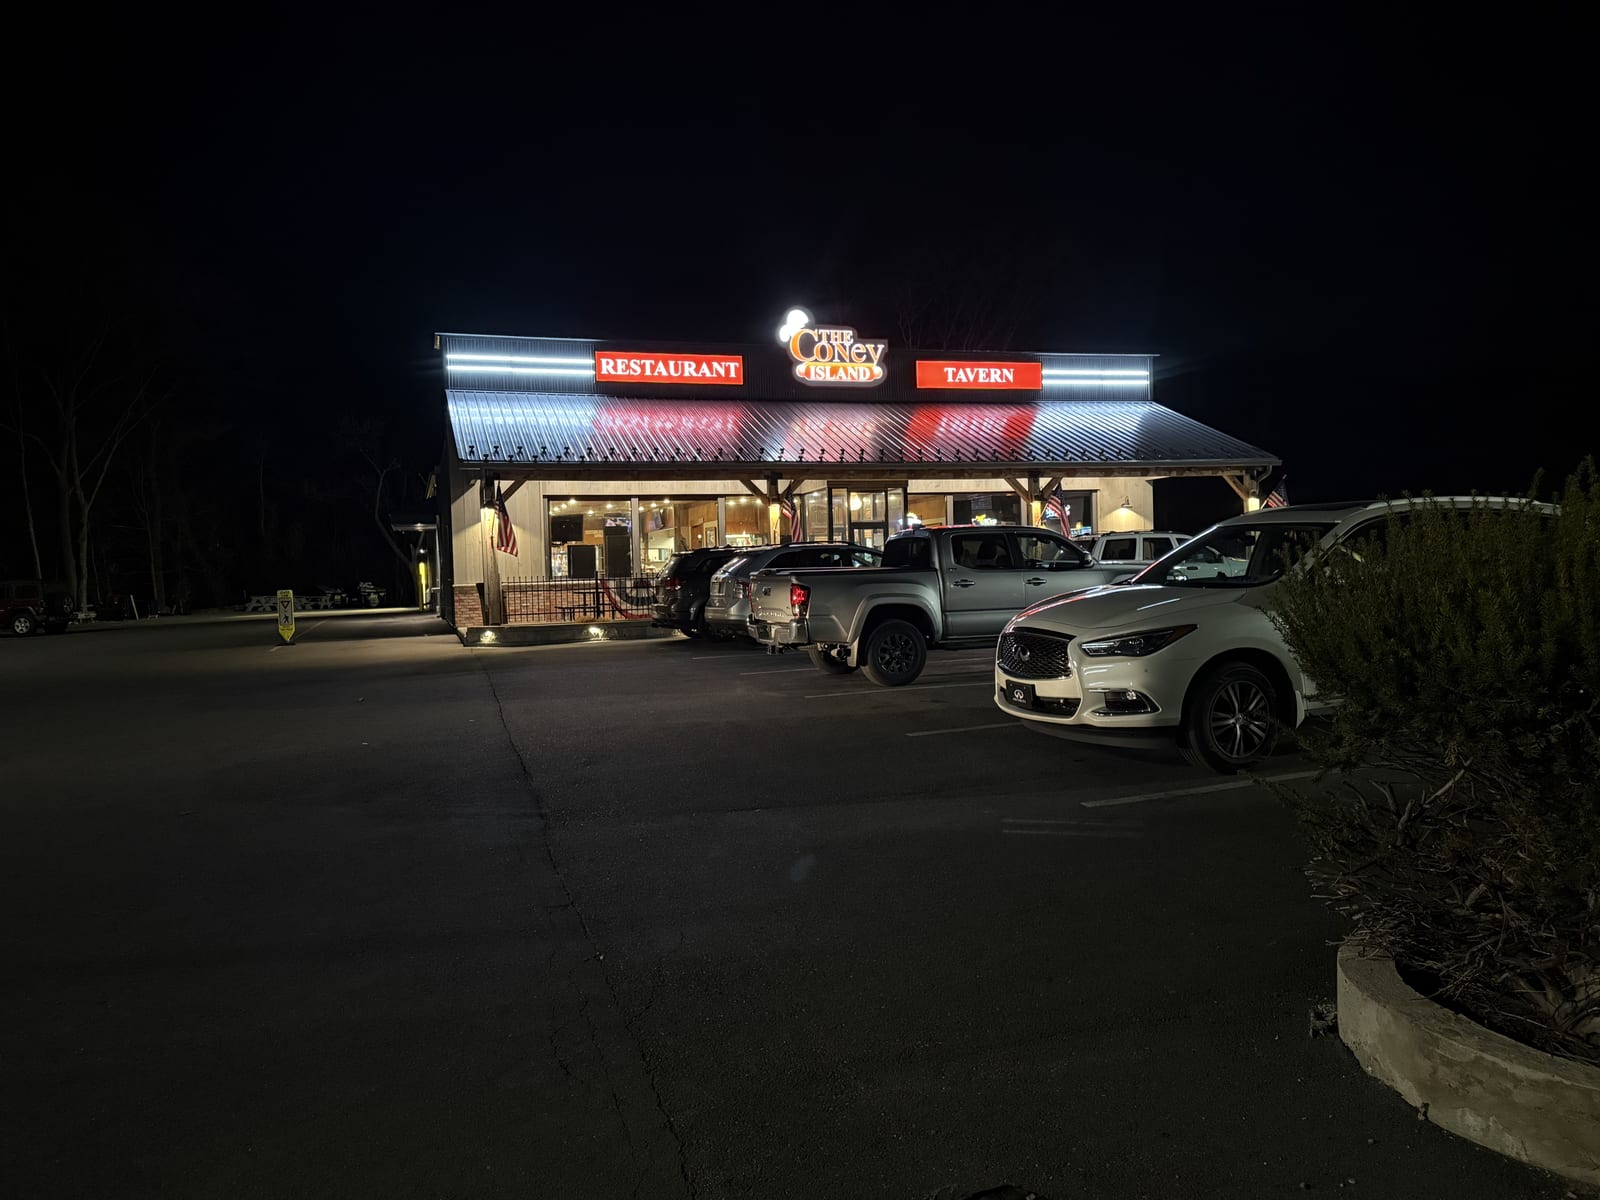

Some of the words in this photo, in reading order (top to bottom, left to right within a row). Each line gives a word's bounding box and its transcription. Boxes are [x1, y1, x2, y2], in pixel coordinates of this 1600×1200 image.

[819, 329, 854, 343] THE
[600, 358, 739, 378] RESTAURANT
[810, 365, 871, 380] ISLAND
[944, 367, 1014, 383] TAVERN
